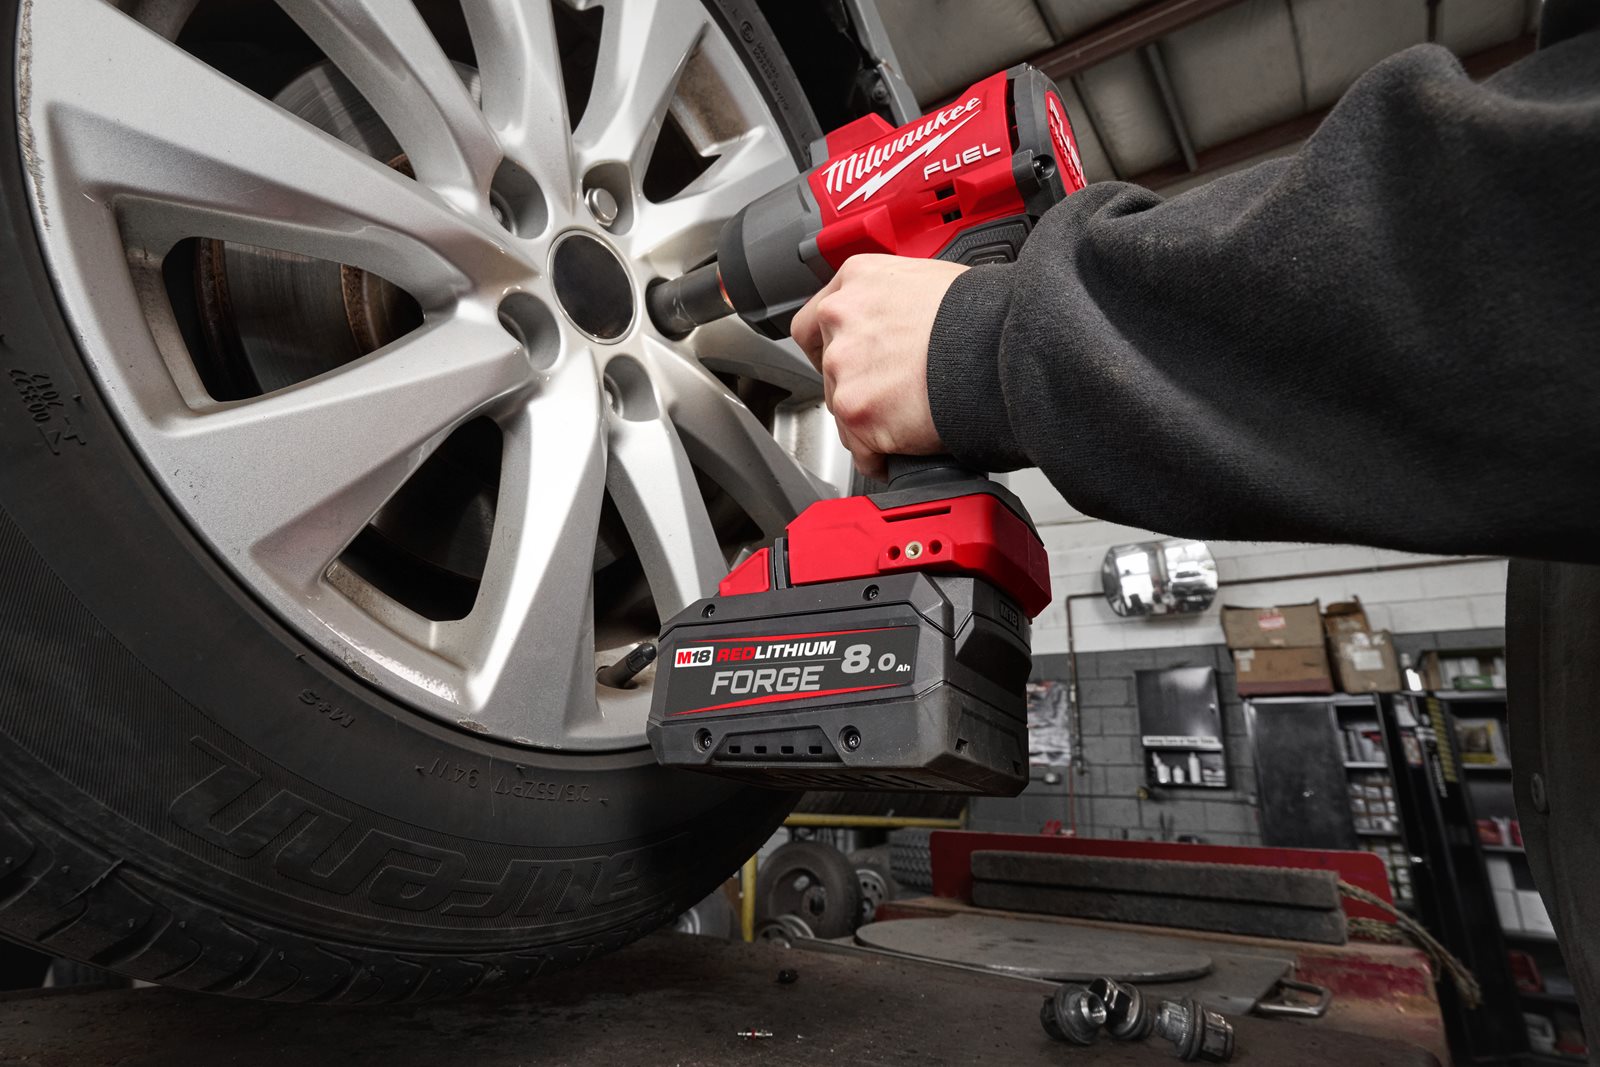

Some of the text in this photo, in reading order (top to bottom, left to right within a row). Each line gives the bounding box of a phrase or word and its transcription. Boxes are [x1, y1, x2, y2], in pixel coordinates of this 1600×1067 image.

[821, 97, 982, 195] Milwaukee
[923, 142, 1002, 181] FUEL
[677, 640, 837, 666] M18 REDLITHIUM
[840, 643, 911, 674] 8.0 Ah
[710, 665, 825, 696] FORGE
[298, 689, 356, 729] M+S
